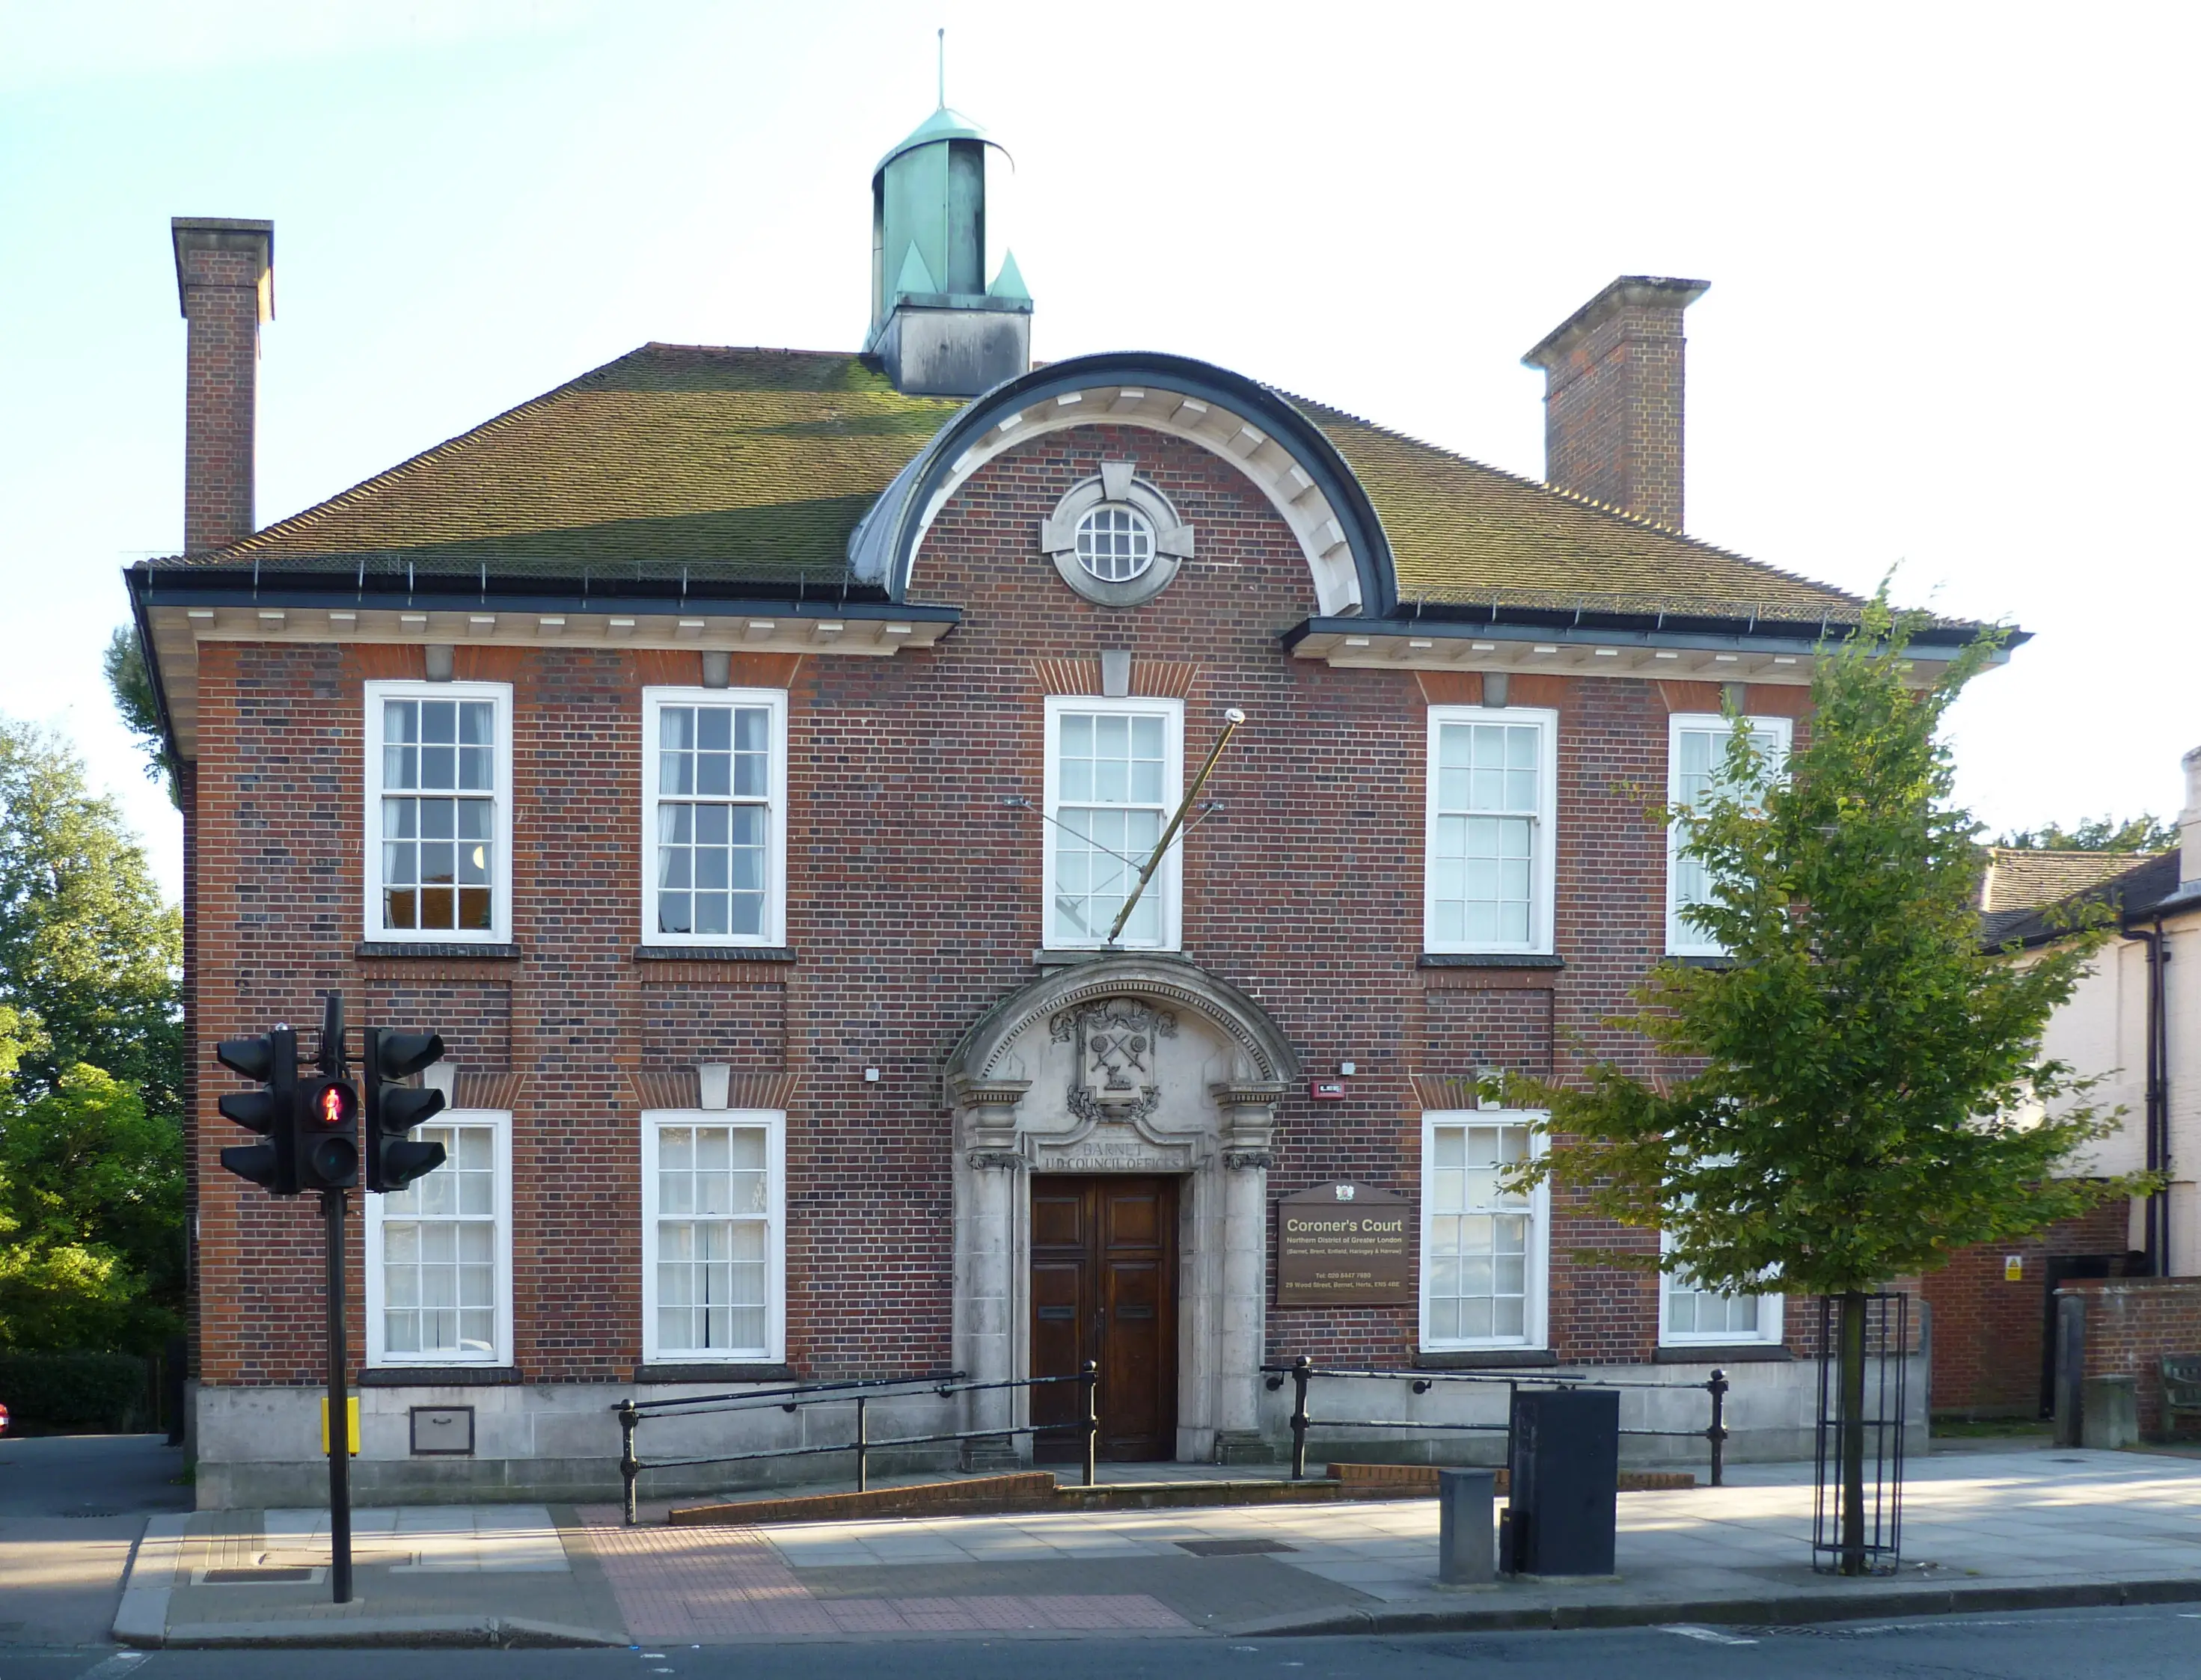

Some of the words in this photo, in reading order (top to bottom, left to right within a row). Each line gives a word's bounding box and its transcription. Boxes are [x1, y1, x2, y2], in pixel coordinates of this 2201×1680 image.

[1083, 1143, 1142, 1156] BARNET
[1287, 1218, 1357, 1232] Coroner's
[1362, 1218, 1402, 1232] Court
[1350, 1248, 1374, 1256] Haringey
